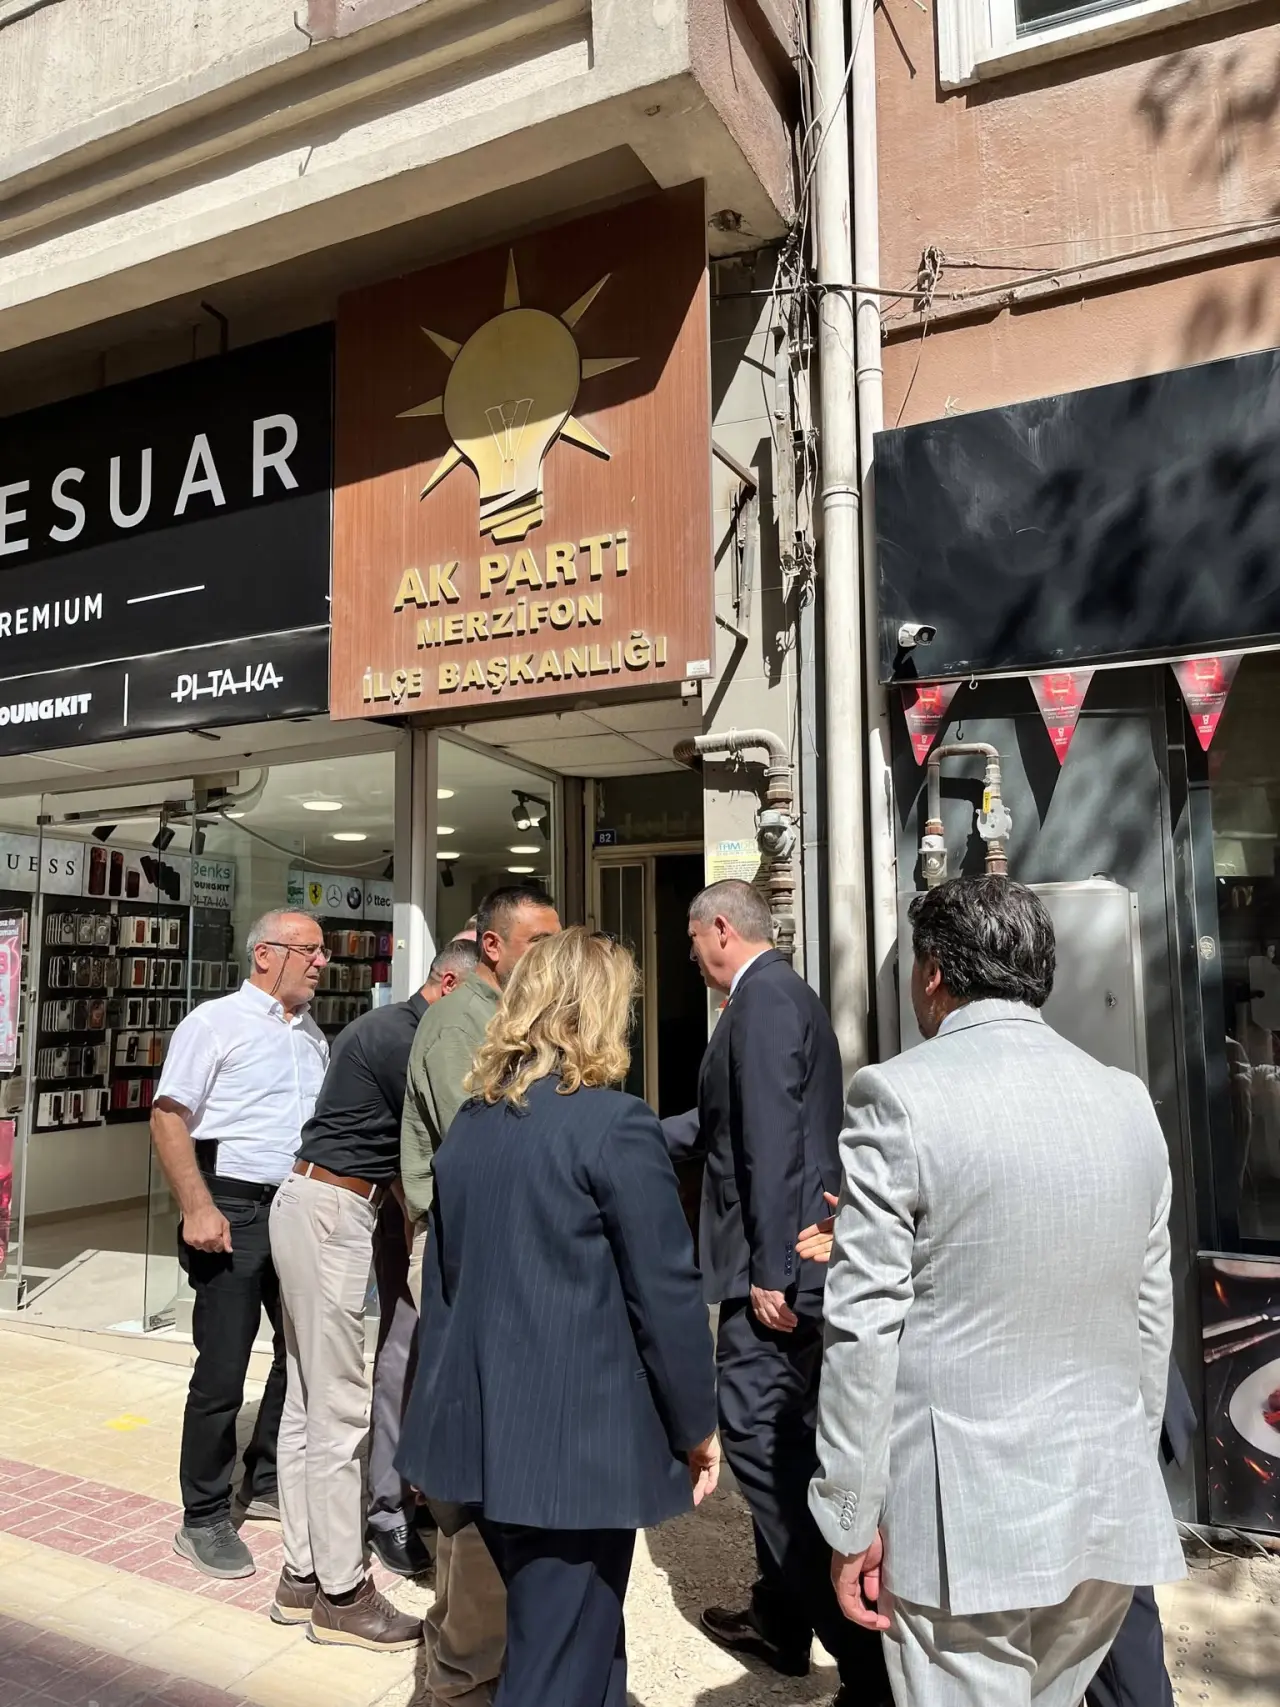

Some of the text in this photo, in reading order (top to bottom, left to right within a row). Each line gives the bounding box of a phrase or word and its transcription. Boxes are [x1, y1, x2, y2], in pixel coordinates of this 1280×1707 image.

[0, 413, 299, 556] ESUAR
[394, 530, 630, 613] AK PARTİ
[0, 592, 103, 638] REMIUM
[416, 592, 603, 651] MERZİFON
[362, 630, 667, 706] İLÇE BAŞKANLIĞI
[599, 833, 611, 844] 82
[373, 894, 391, 907] ttec
